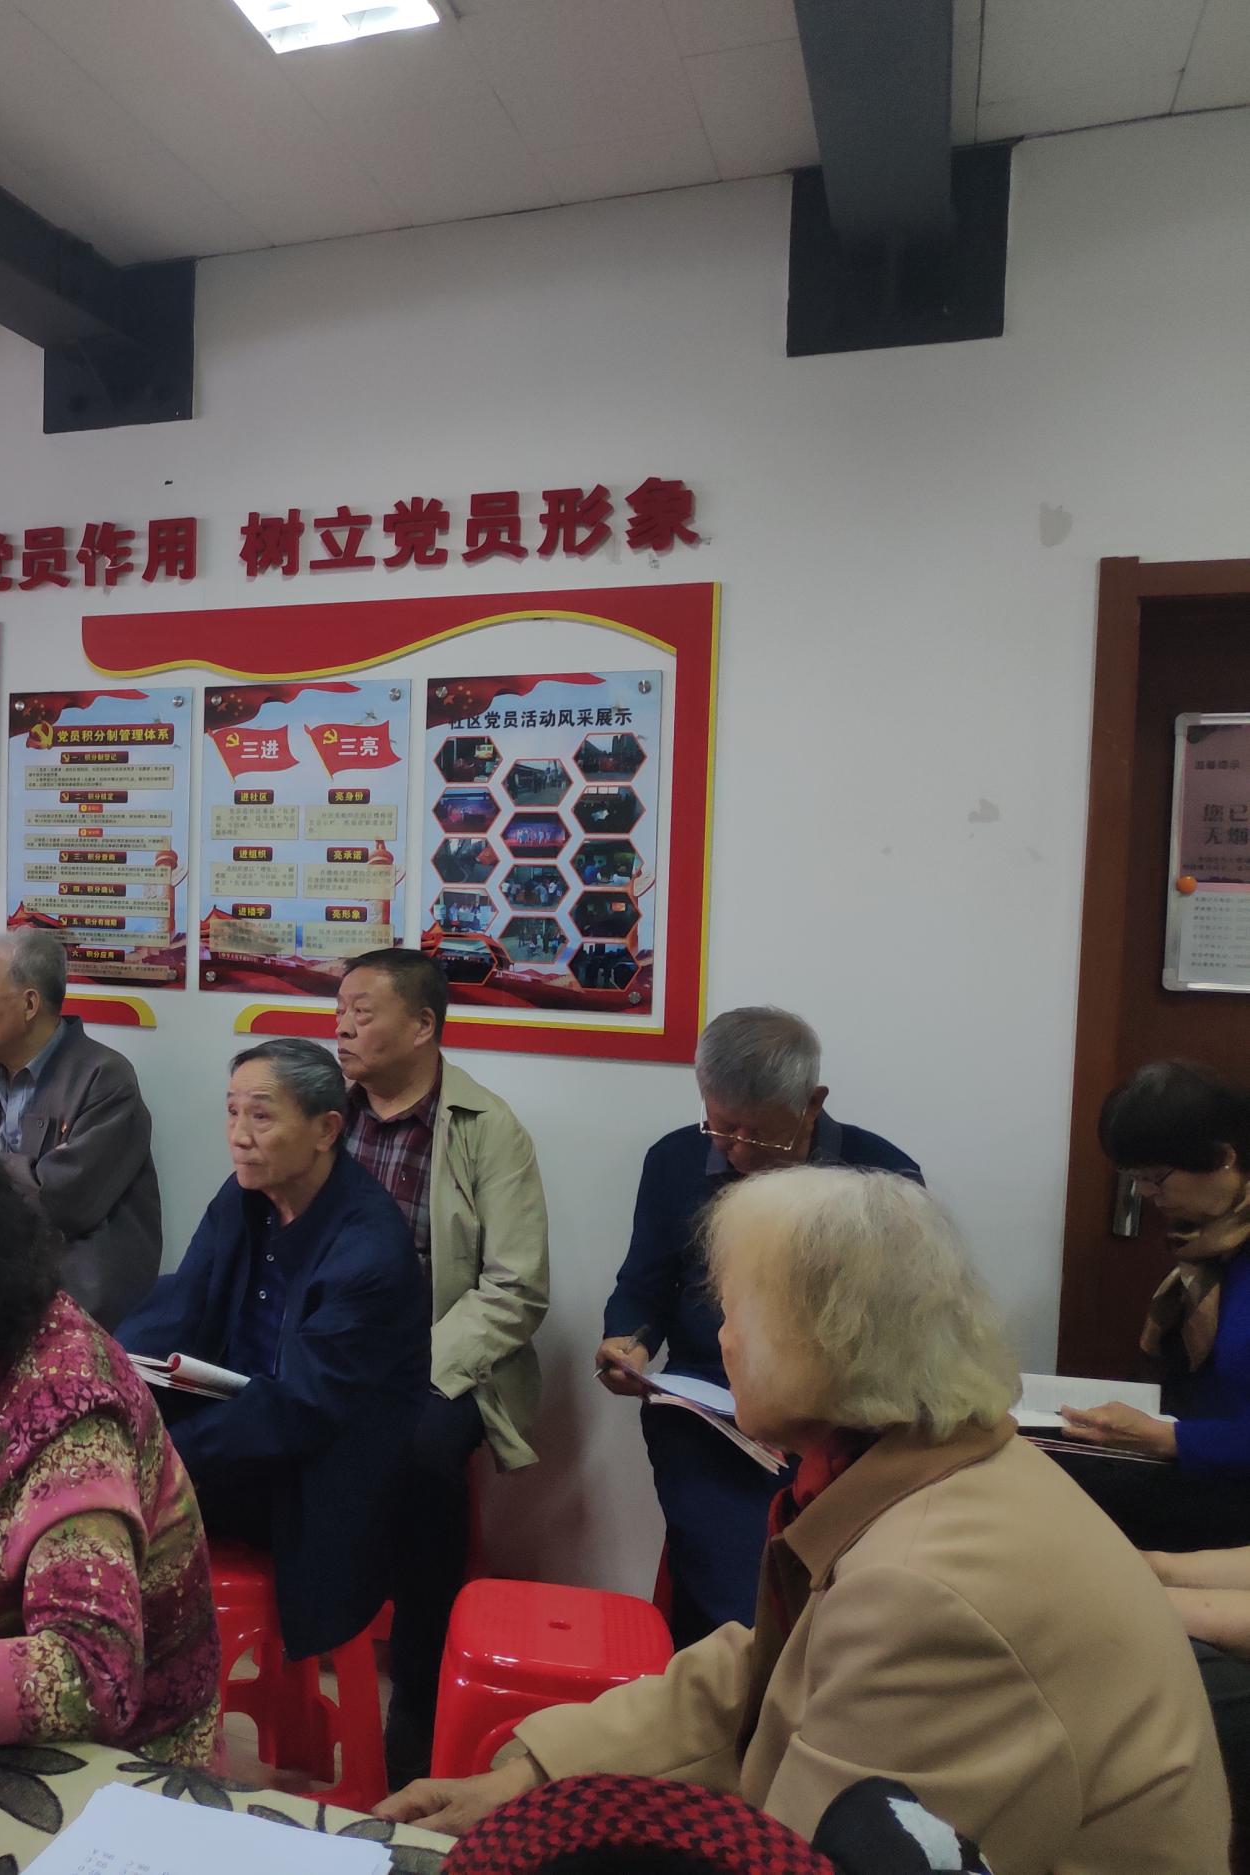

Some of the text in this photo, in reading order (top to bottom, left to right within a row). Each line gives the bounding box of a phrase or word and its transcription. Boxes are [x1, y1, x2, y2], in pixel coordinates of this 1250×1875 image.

[239, 476, 700, 577] 树立党员形象
[449, 707, 632, 730] 社区党员活动风采展示
[57, 728, 169, 743] 党员积分制管理体系
[240, 741, 279, 760] 三进
[338, 737, 379, 756] 三亮
[334, 791, 364, 801] 亮身份
[333, 850, 362, 860] 亮承诺
[332, 909, 360, 919] 亮形象
